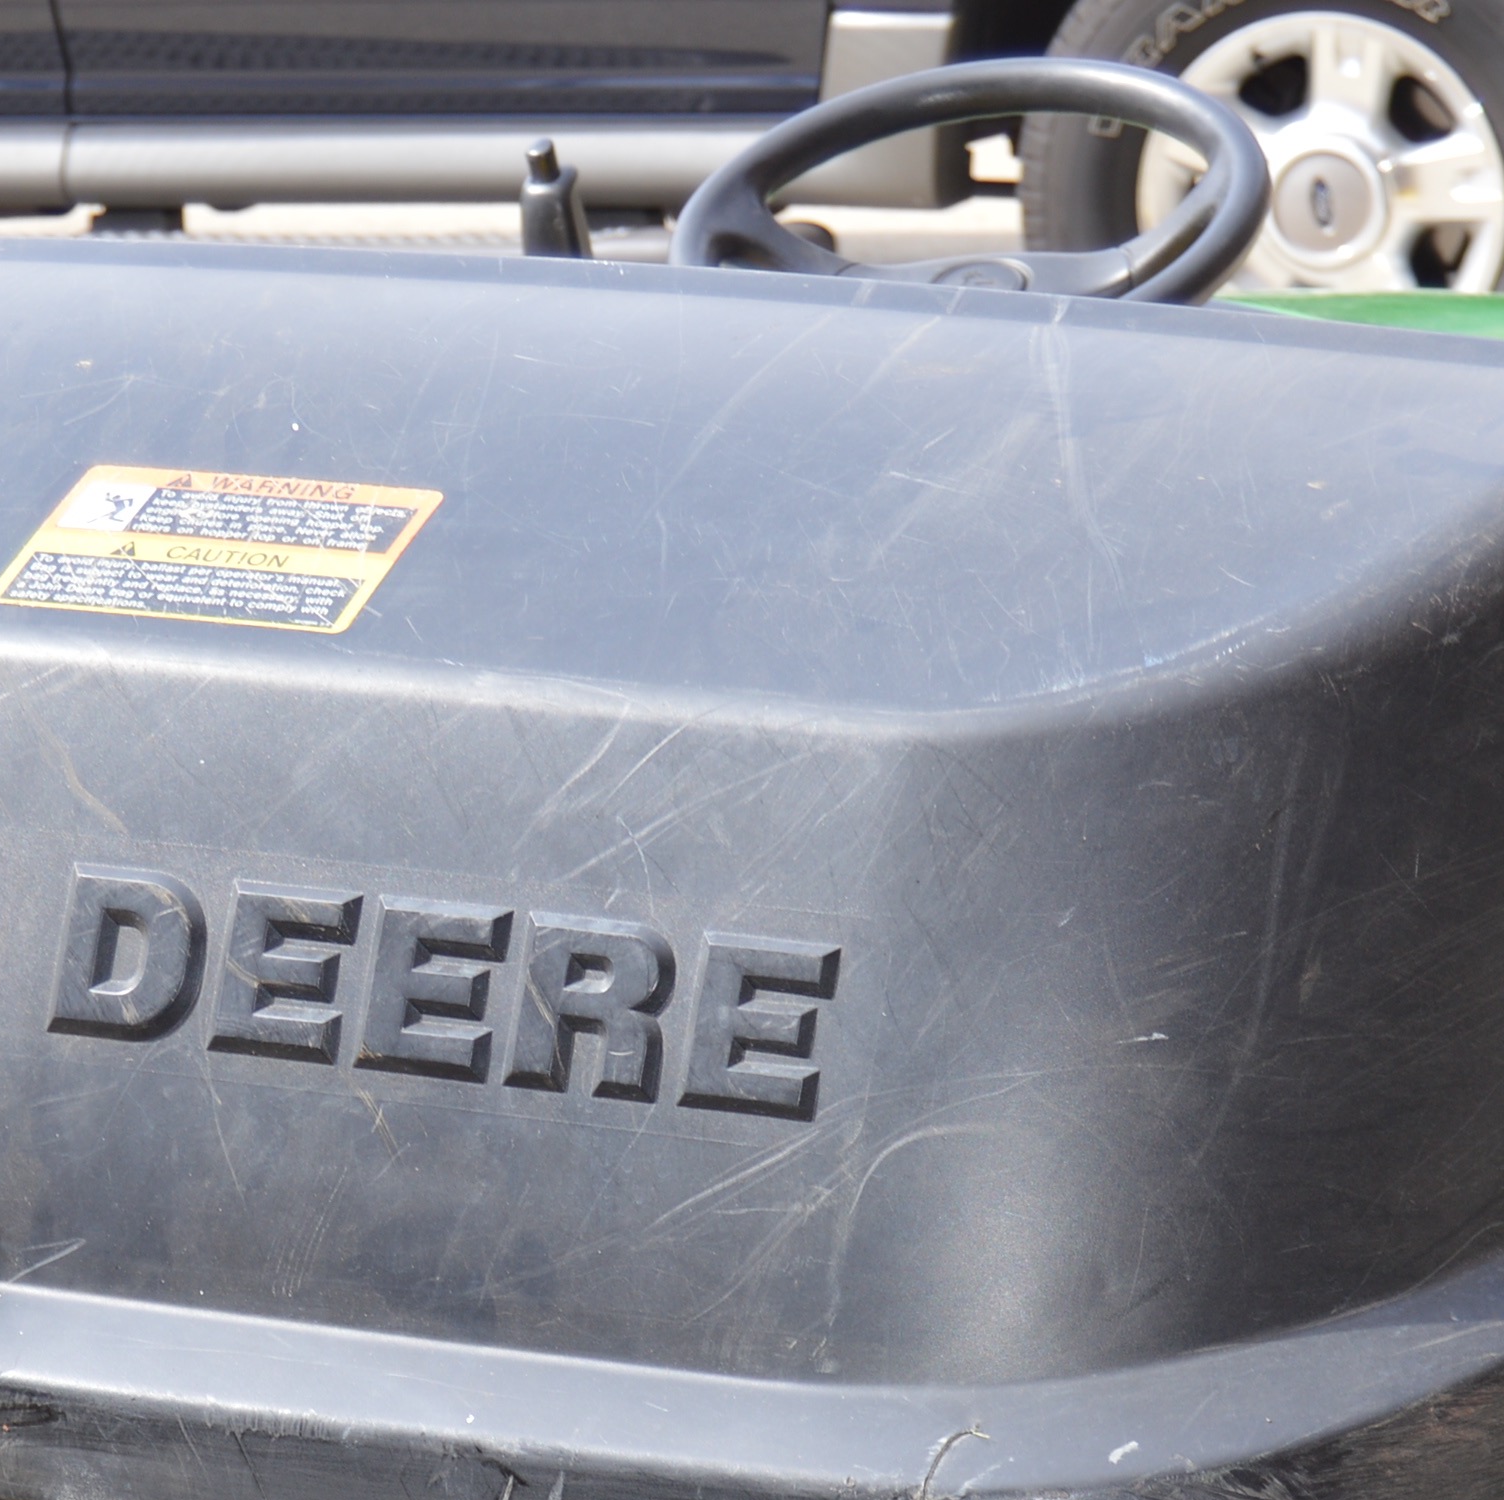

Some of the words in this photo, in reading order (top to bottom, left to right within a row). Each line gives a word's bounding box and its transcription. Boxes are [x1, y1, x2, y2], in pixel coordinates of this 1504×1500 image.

[211, 475, 355, 499] WARNING
[223, 495, 260, 504] injury
[266, 498, 297, 507] from
[200, 527, 248, 538] hopper
[58, 555, 93, 564] avoid
[140, 562, 186, 572] ballast
[189, 567, 212, 575] per
[165, 545, 290, 566] CAUTION
[181, 576, 207, 584] and
[305, 586, 348, 596] check
[109, 588, 135, 597] bag
[155, 592, 226, 605] equivalent
[228, 598, 245, 606] to
[304, 596, 334, 605] with
[46, 862, 842, 1122] DEERE
